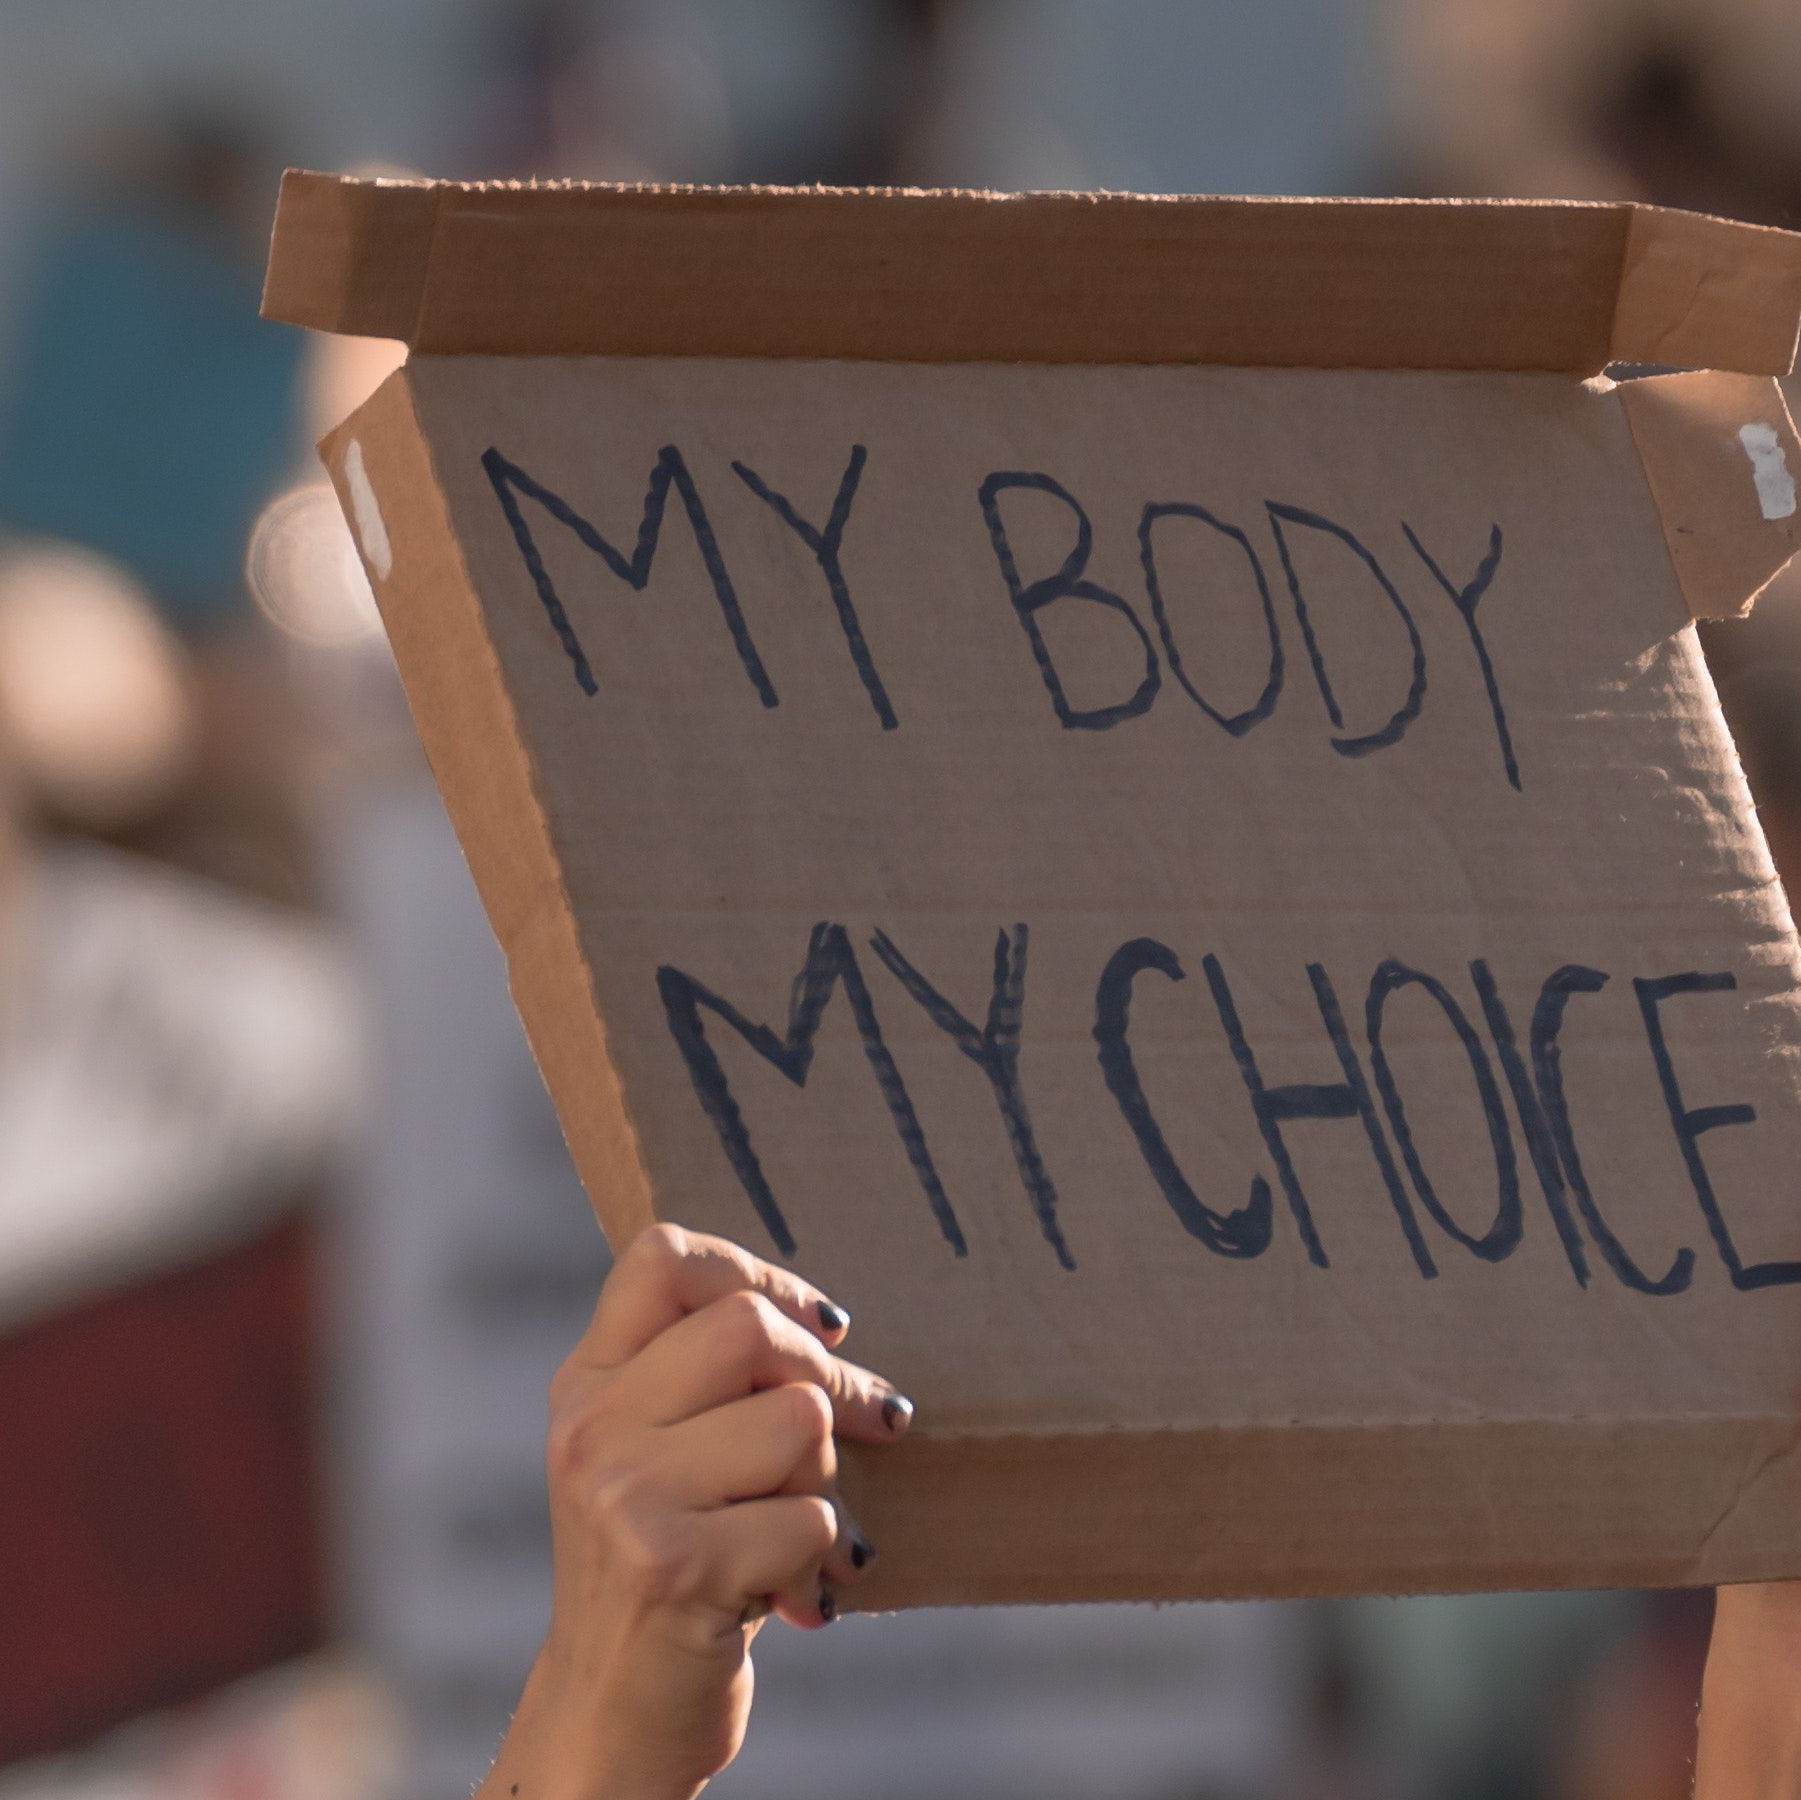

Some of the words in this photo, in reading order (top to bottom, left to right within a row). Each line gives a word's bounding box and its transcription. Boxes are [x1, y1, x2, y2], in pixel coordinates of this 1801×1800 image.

[481, 444, 901, 732] MY
[978, 470, 1522, 792] BODY
[656, 922, 1076, 1272] MY
